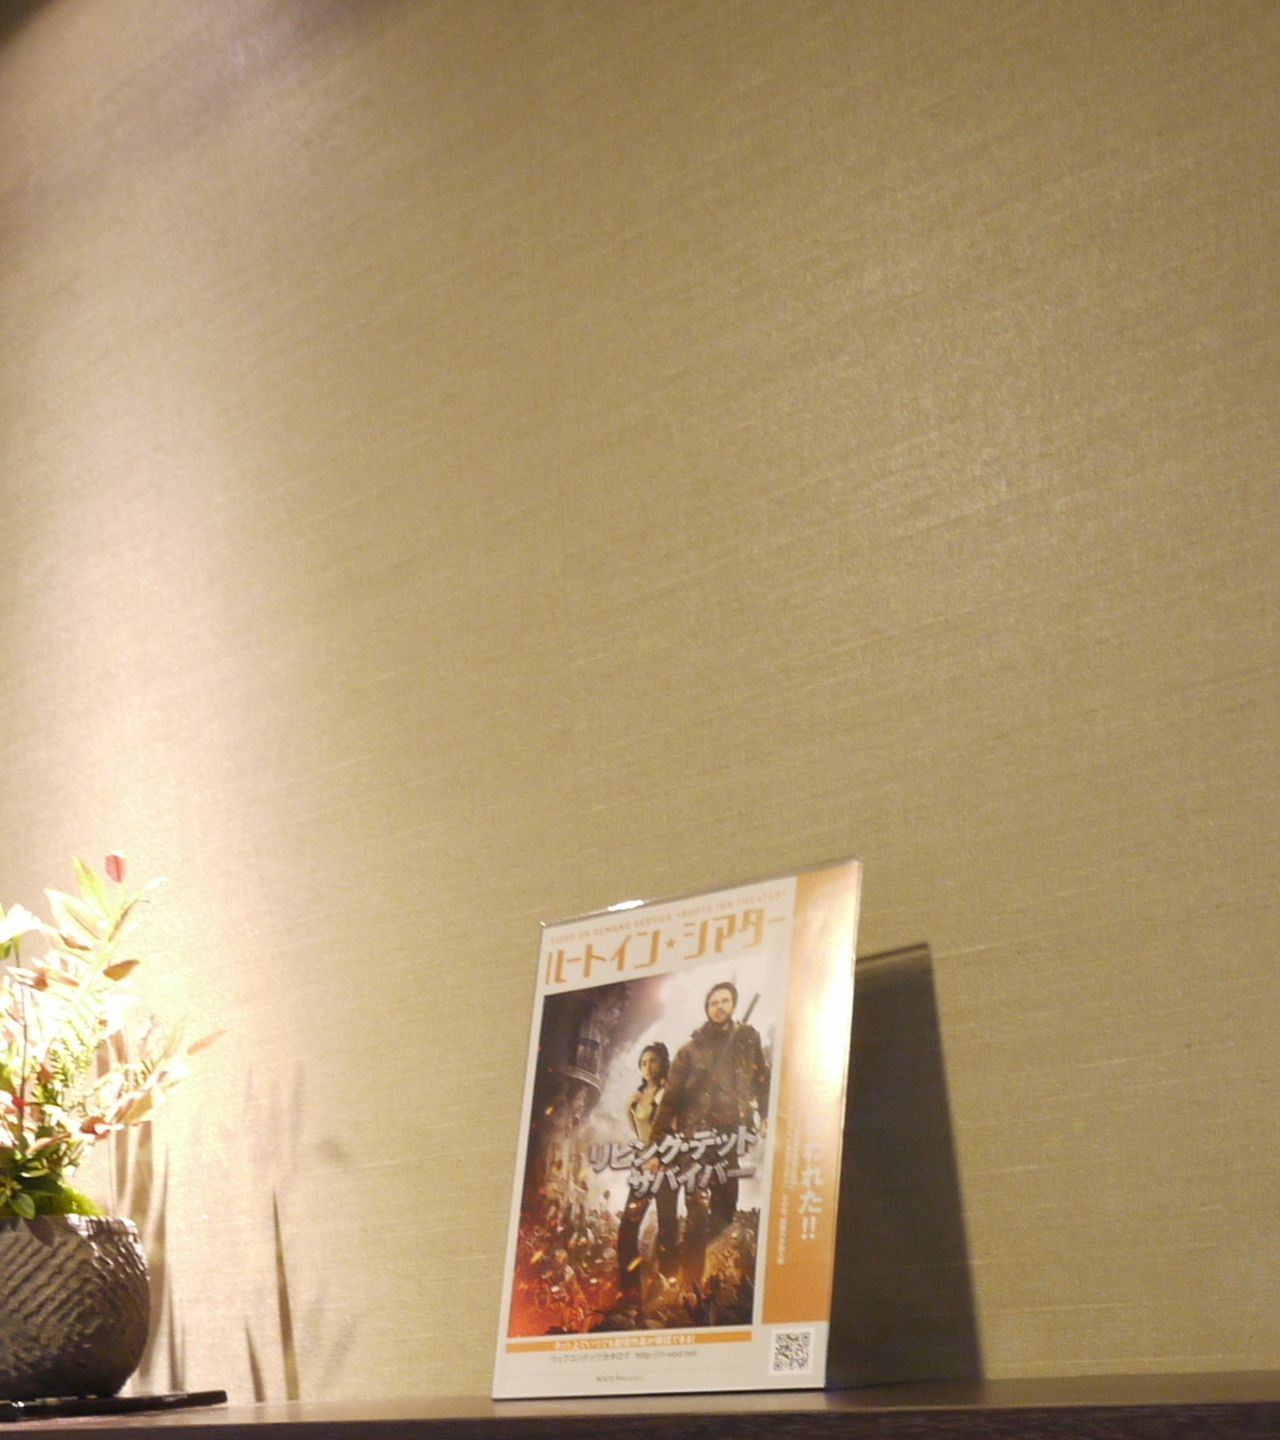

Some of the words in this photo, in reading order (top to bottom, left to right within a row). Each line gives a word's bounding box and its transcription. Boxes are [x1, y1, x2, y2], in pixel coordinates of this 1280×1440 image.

[627, 1159, 756, 1198] サバイバー
